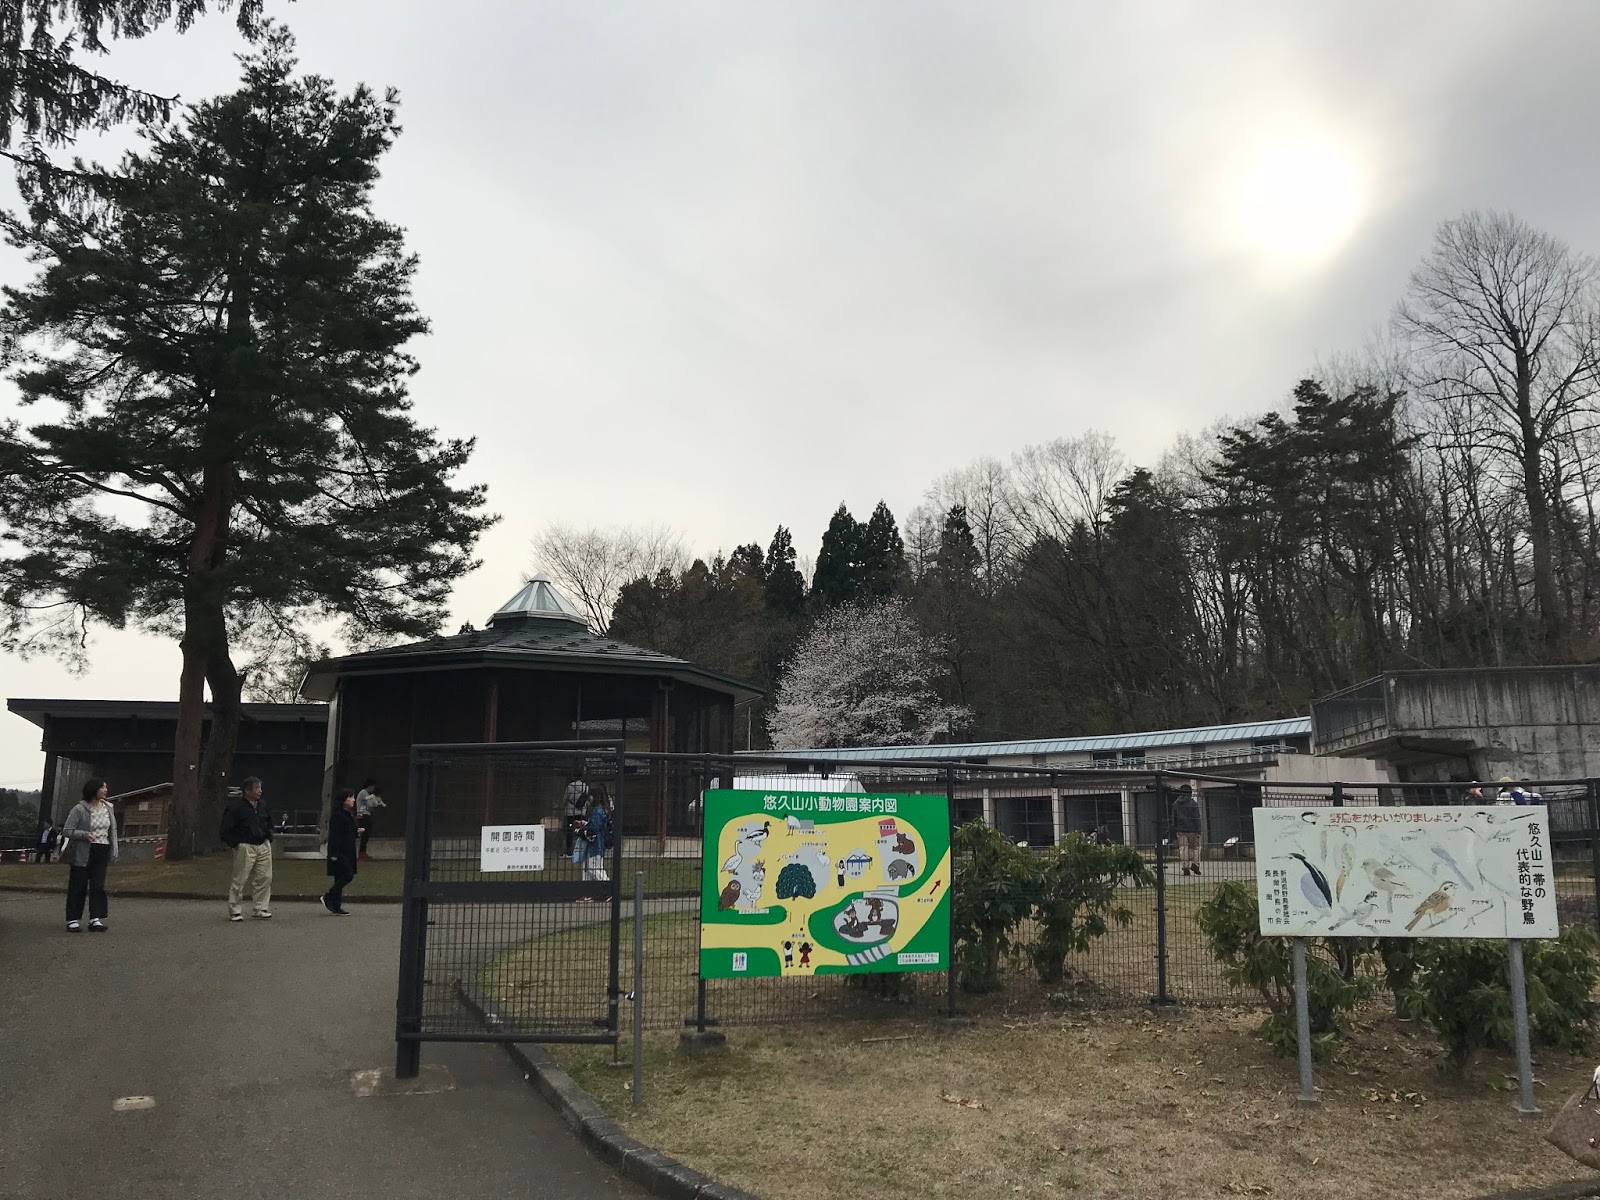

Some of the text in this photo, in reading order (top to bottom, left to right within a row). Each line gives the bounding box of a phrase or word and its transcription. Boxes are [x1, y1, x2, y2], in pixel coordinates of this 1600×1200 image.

[763, 795, 897, 812] 悠久山小動物園案内図
[491, 831, 534, 841] 開園時間
[1528, 823, 1546, 898] 悠久山一帯の
[1516, 848, 1535, 925] 代表的な野鳥
